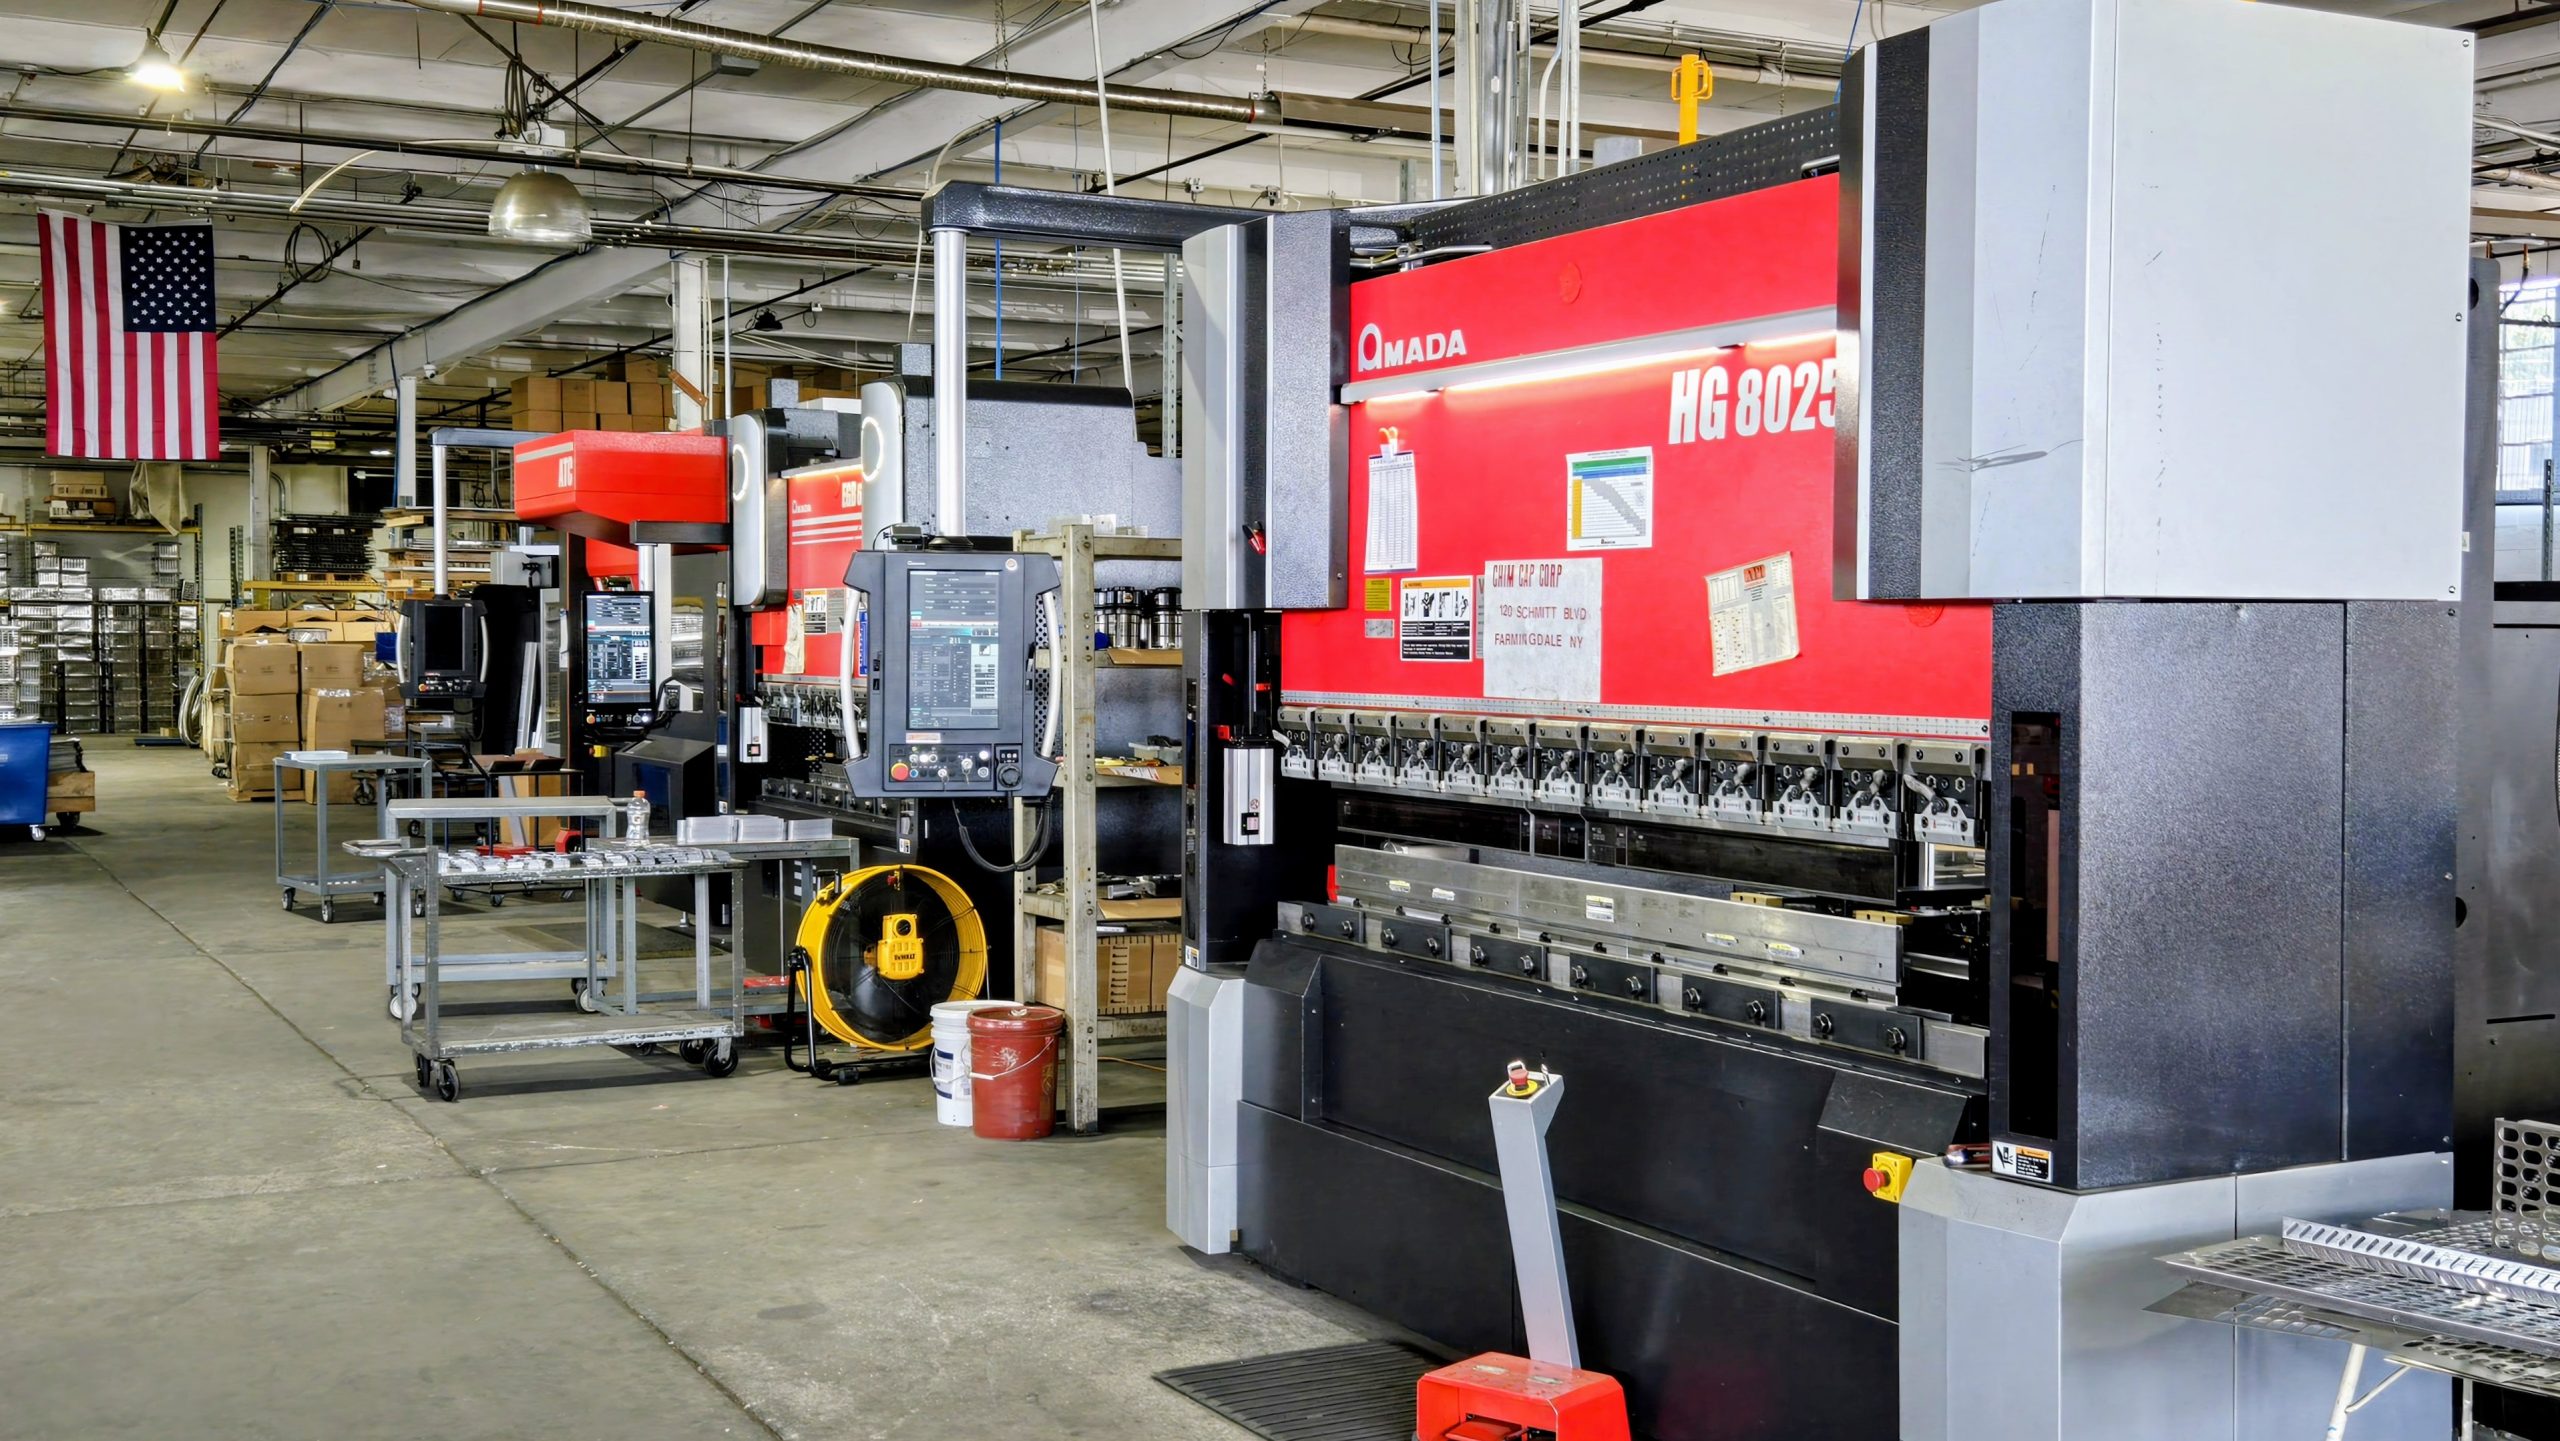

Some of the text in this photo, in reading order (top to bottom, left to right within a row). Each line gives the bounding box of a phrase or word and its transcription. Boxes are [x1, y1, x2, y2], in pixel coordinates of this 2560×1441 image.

[1358, 323, 1467, 373] AMADA
[1668, 357, 1836, 445] HG 8025
[558, 456, 573, 488] ATC
[1492, 564, 1563, 588] CHIM CAP CORP
[1499, 604, 1587, 621] 120 SCHMITT BLVD
[1494, 632, 1584, 648] FARMINGDALE NY
